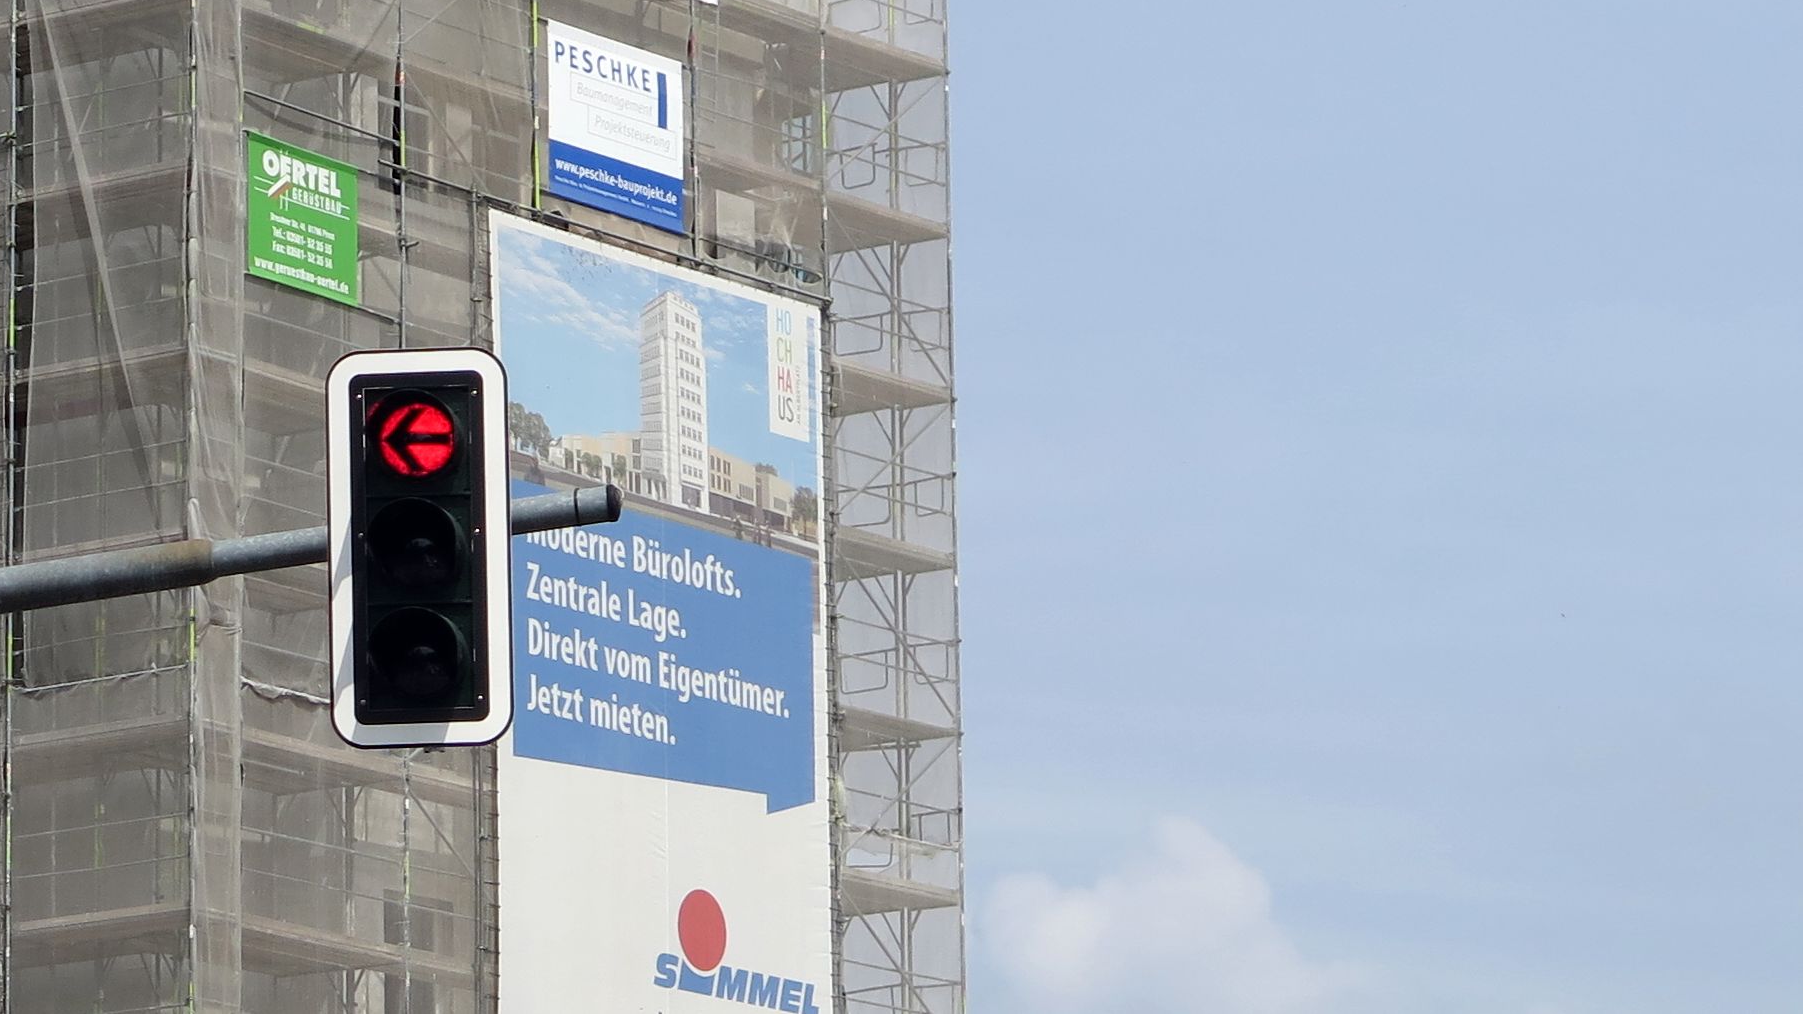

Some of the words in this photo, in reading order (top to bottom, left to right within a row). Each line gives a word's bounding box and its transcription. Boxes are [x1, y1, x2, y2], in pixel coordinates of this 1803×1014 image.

[554, 40, 652, 93] PESCHKE
[577, 81, 653, 117] Baumanagement
[262, 149, 342, 198] OERTEL
[555, 158, 678, 206] www.peschke-bauprojekt.de
[776, 308, 791, 335] HO
[776, 337, 793, 364] CH
[777, 366, 794, 394] HA
[778, 394, 794, 423] US
[632, 535, 741, 599] Bürolofts.
[526, 562, 621, 622] Zentrale
[628, 588, 687, 642] Lage.
[527, 618, 598, 671] Direkt
[603, 645, 651, 684] vom
[658, 650, 790, 718] Eigentümer.
[527, 673, 584, 723] Jetzt
[590, 694, 676, 746] mieten.
[653, 952, 820, 1013] SIMMEL
